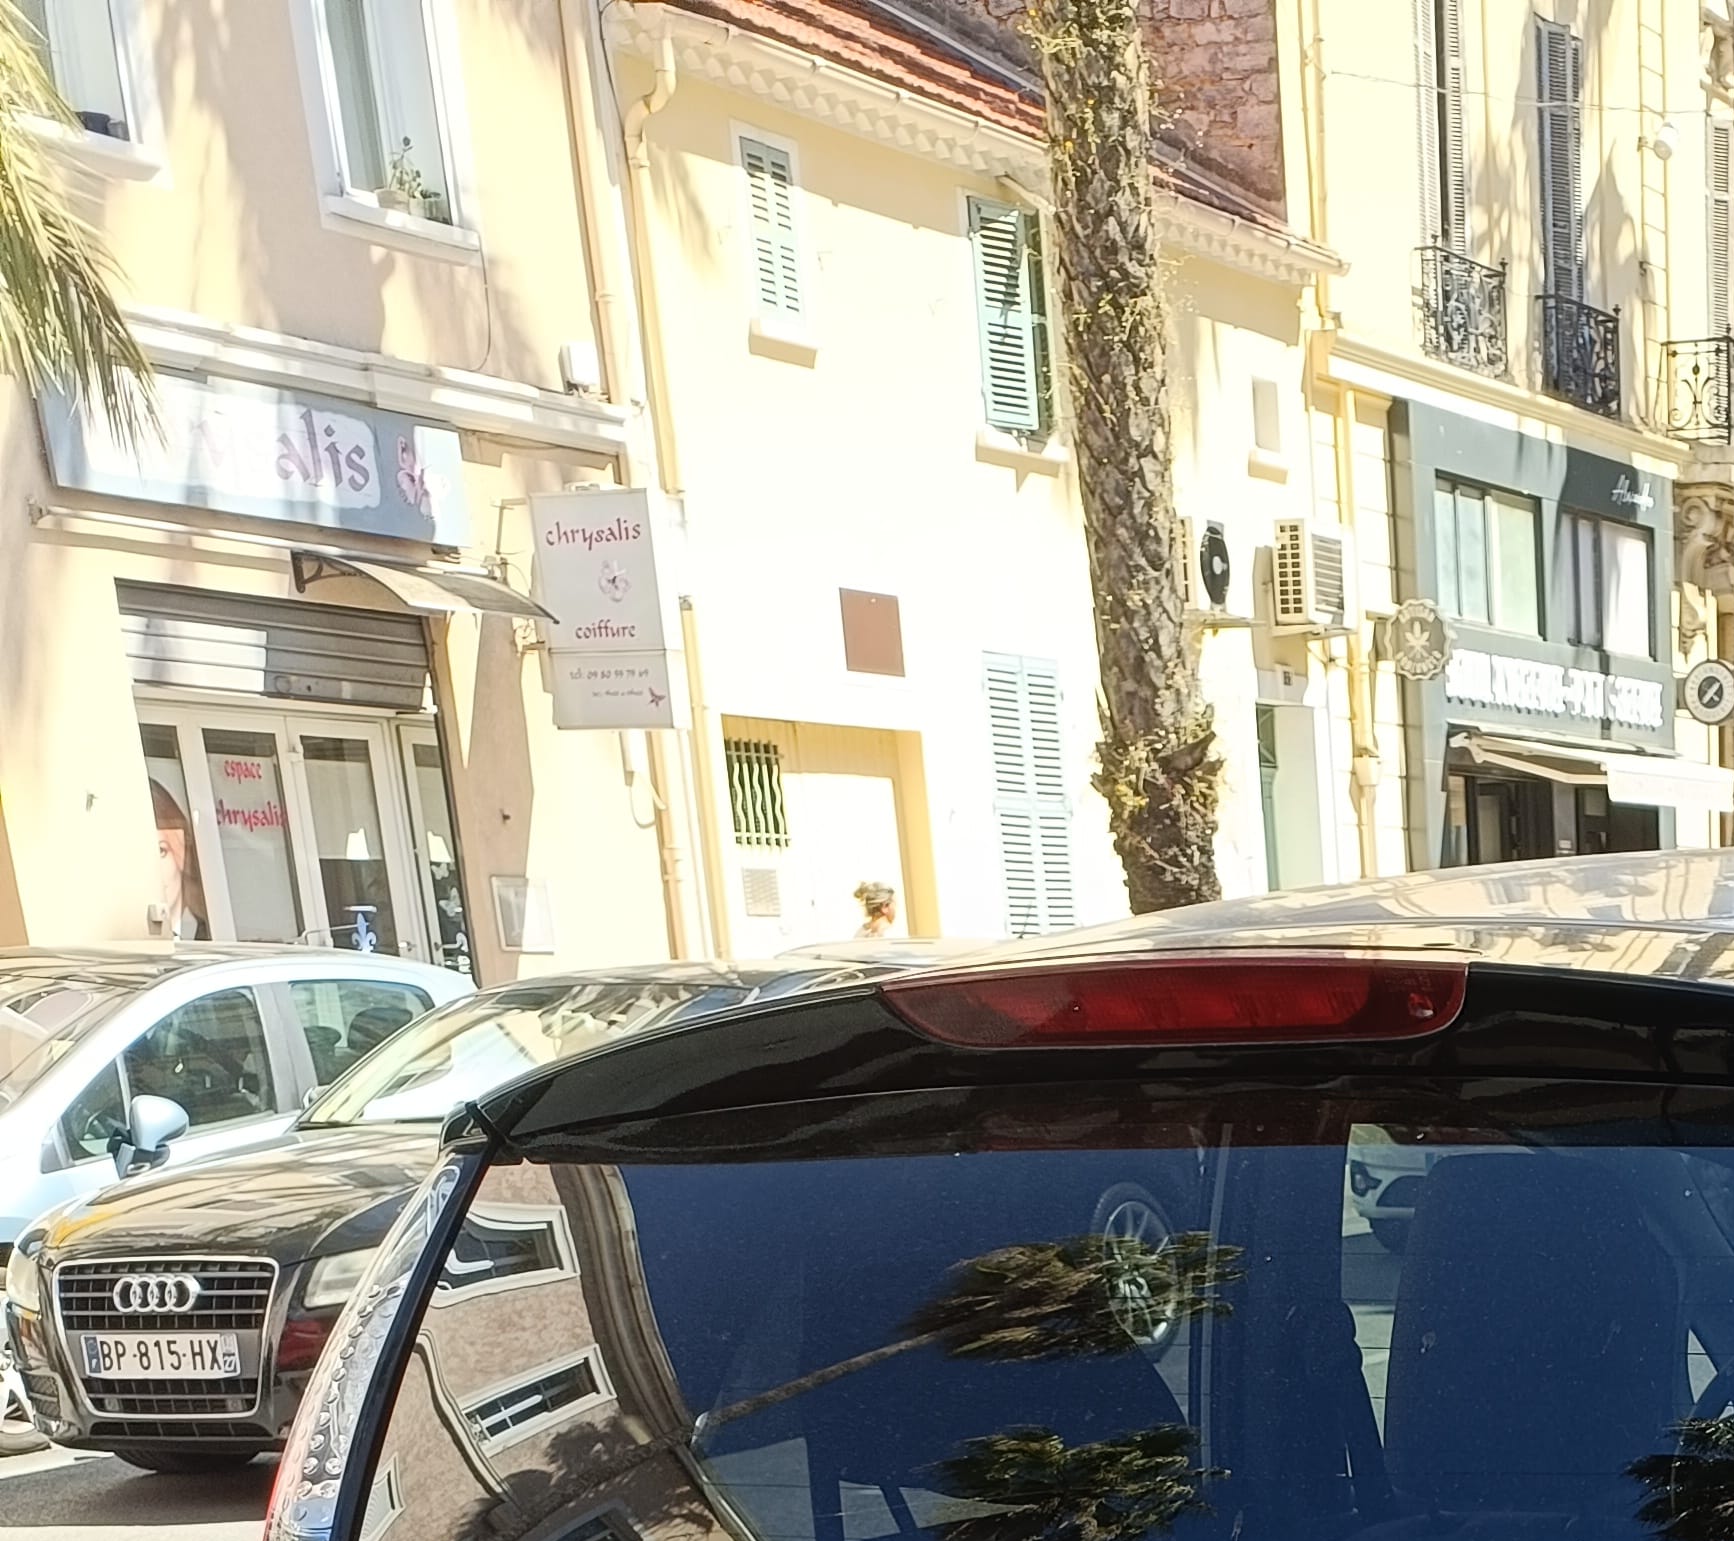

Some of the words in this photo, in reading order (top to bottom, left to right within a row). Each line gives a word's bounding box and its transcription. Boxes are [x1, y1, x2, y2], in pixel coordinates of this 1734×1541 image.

[546, 518, 641, 551] chrysalis
[575, 620, 636, 639] coiffure
[224, 760, 262, 784] espace
[99, 1340, 222, 1371] BP-815-HX
